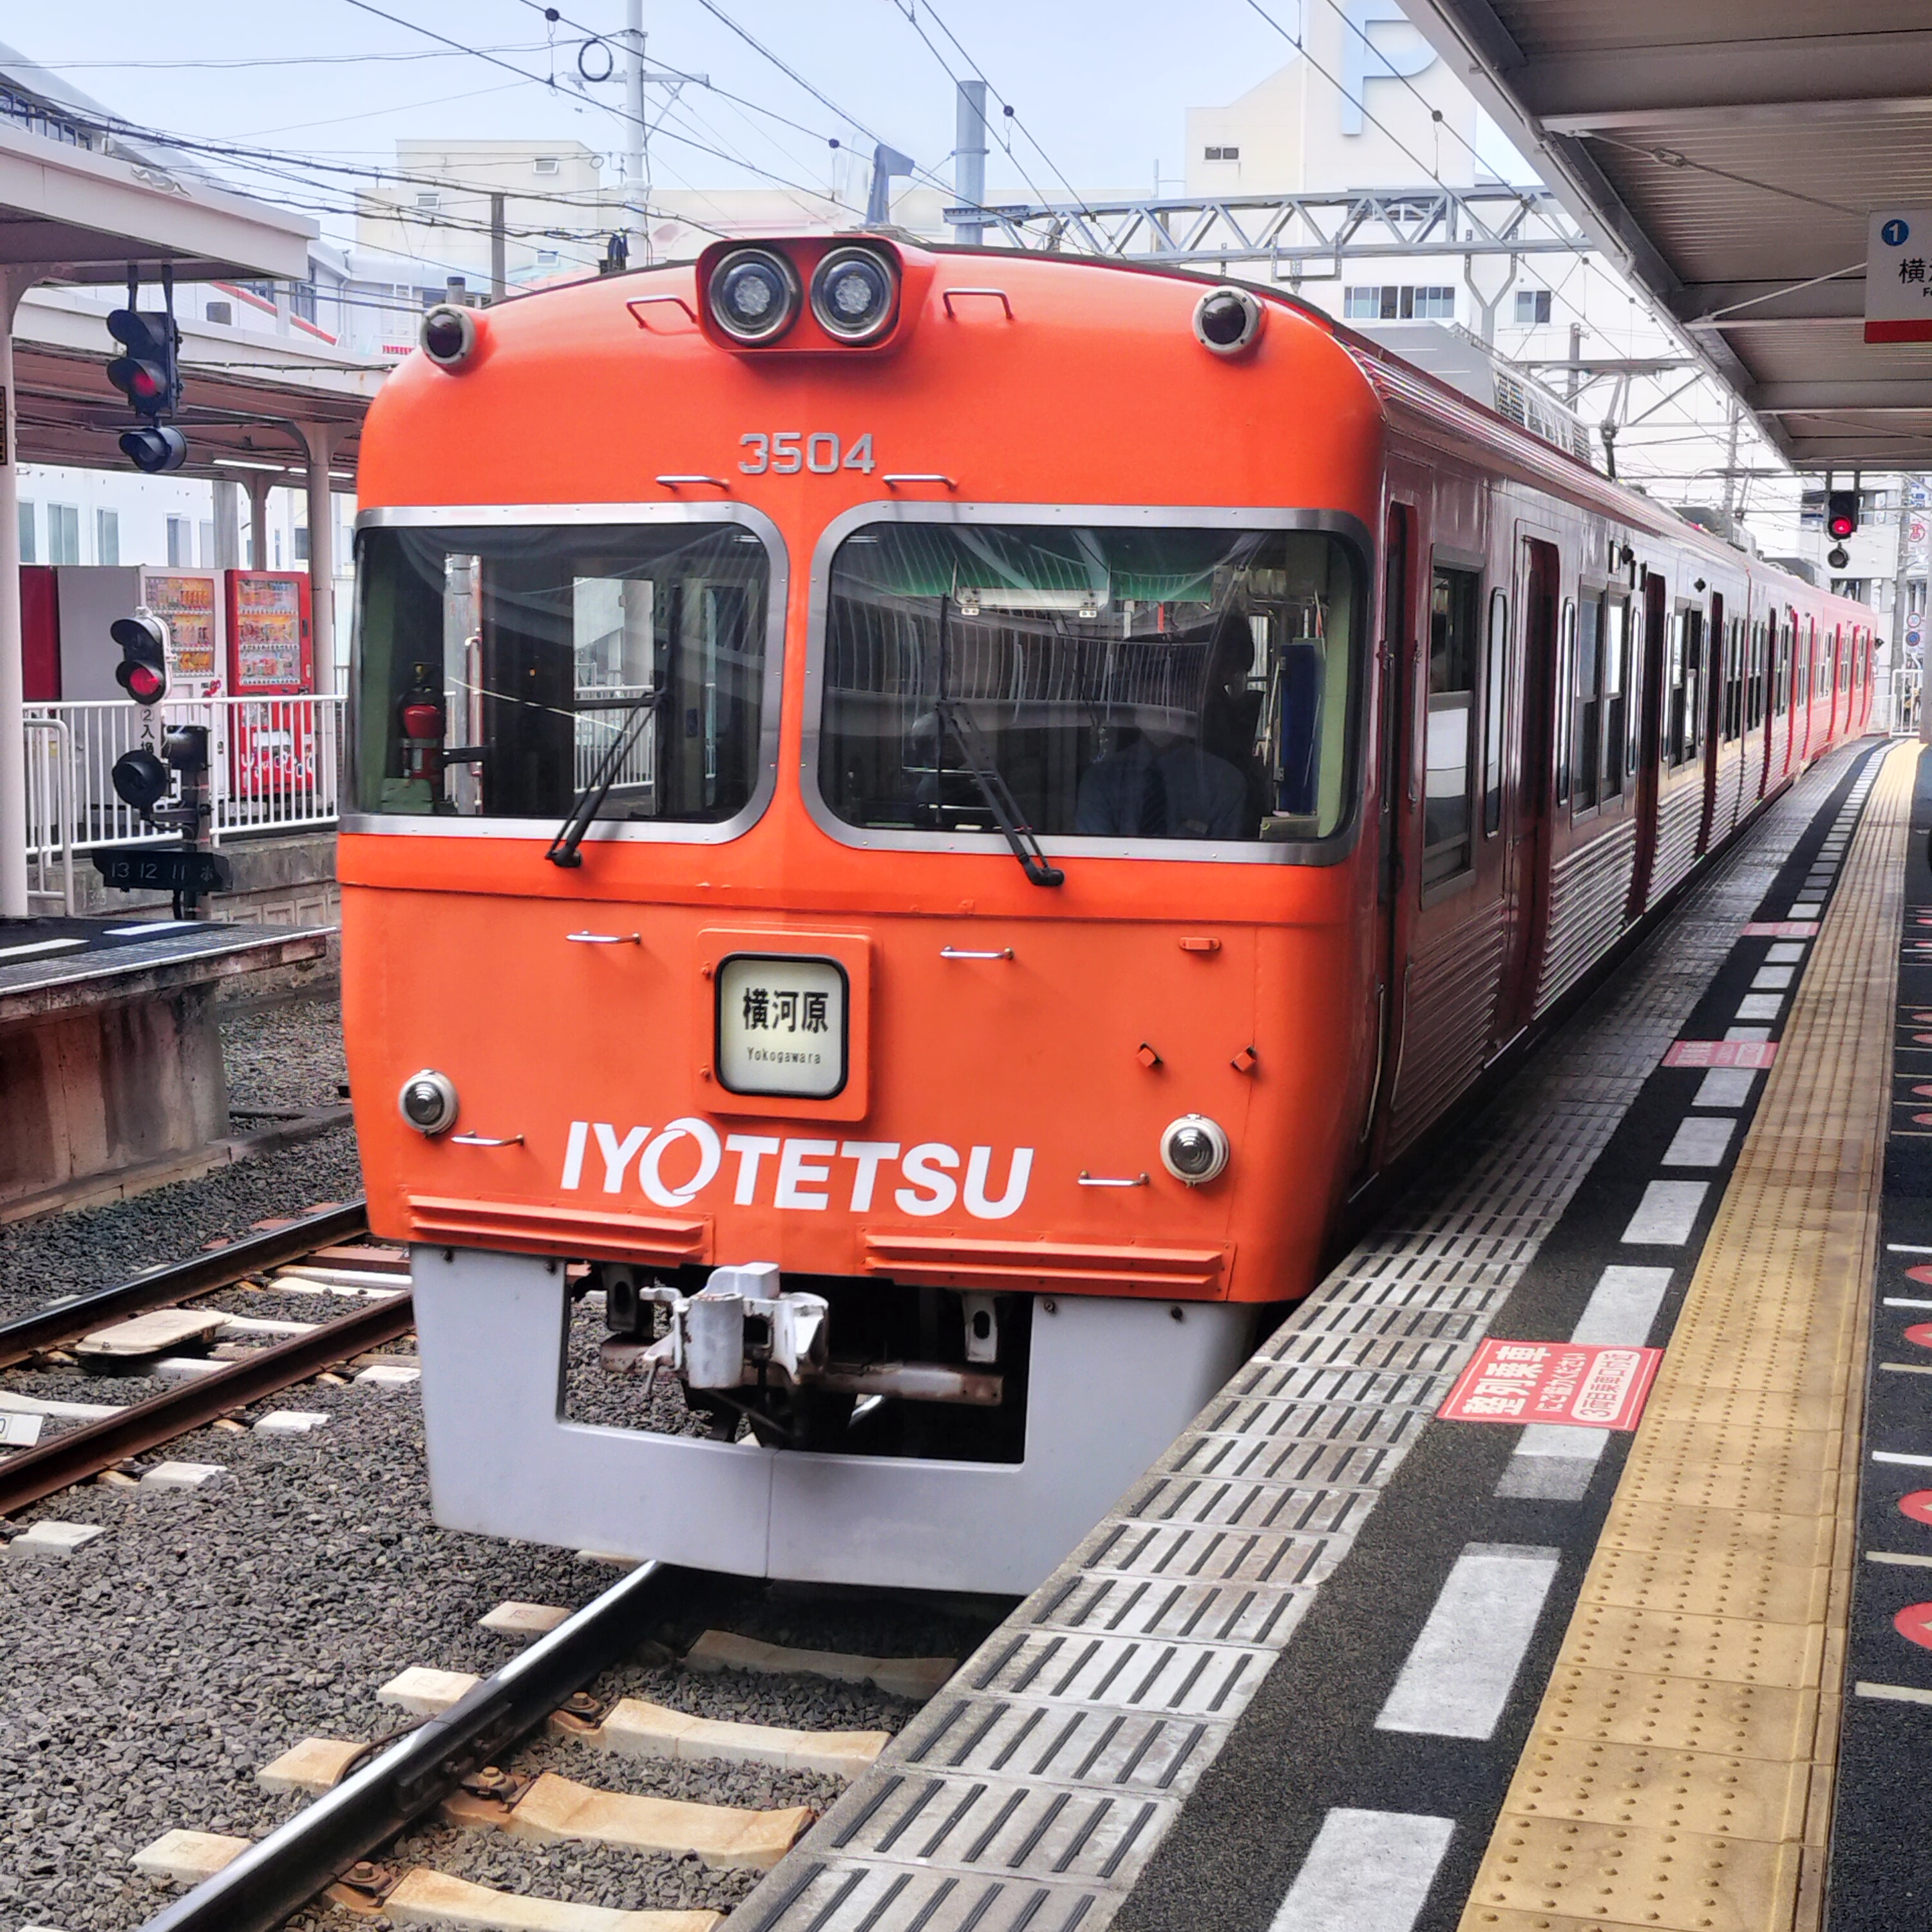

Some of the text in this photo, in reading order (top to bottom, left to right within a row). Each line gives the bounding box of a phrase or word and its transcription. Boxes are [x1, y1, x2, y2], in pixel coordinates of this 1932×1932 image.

[1899, 258, 1932, 285] 横
[738, 432, 876, 474] 3504
[111, 862, 130, 878] 13
[140, 863, 157, 879] 12
[743, 987, 829, 1033] 横河原
[747, 1047, 821, 1064] Yokogawara
[560, 1117, 1035, 1220] IYOTETSU
[1462, 1345, 1551, 1416] 整列乗車
[1535, 1353, 1587, 1412] にご協力ください
